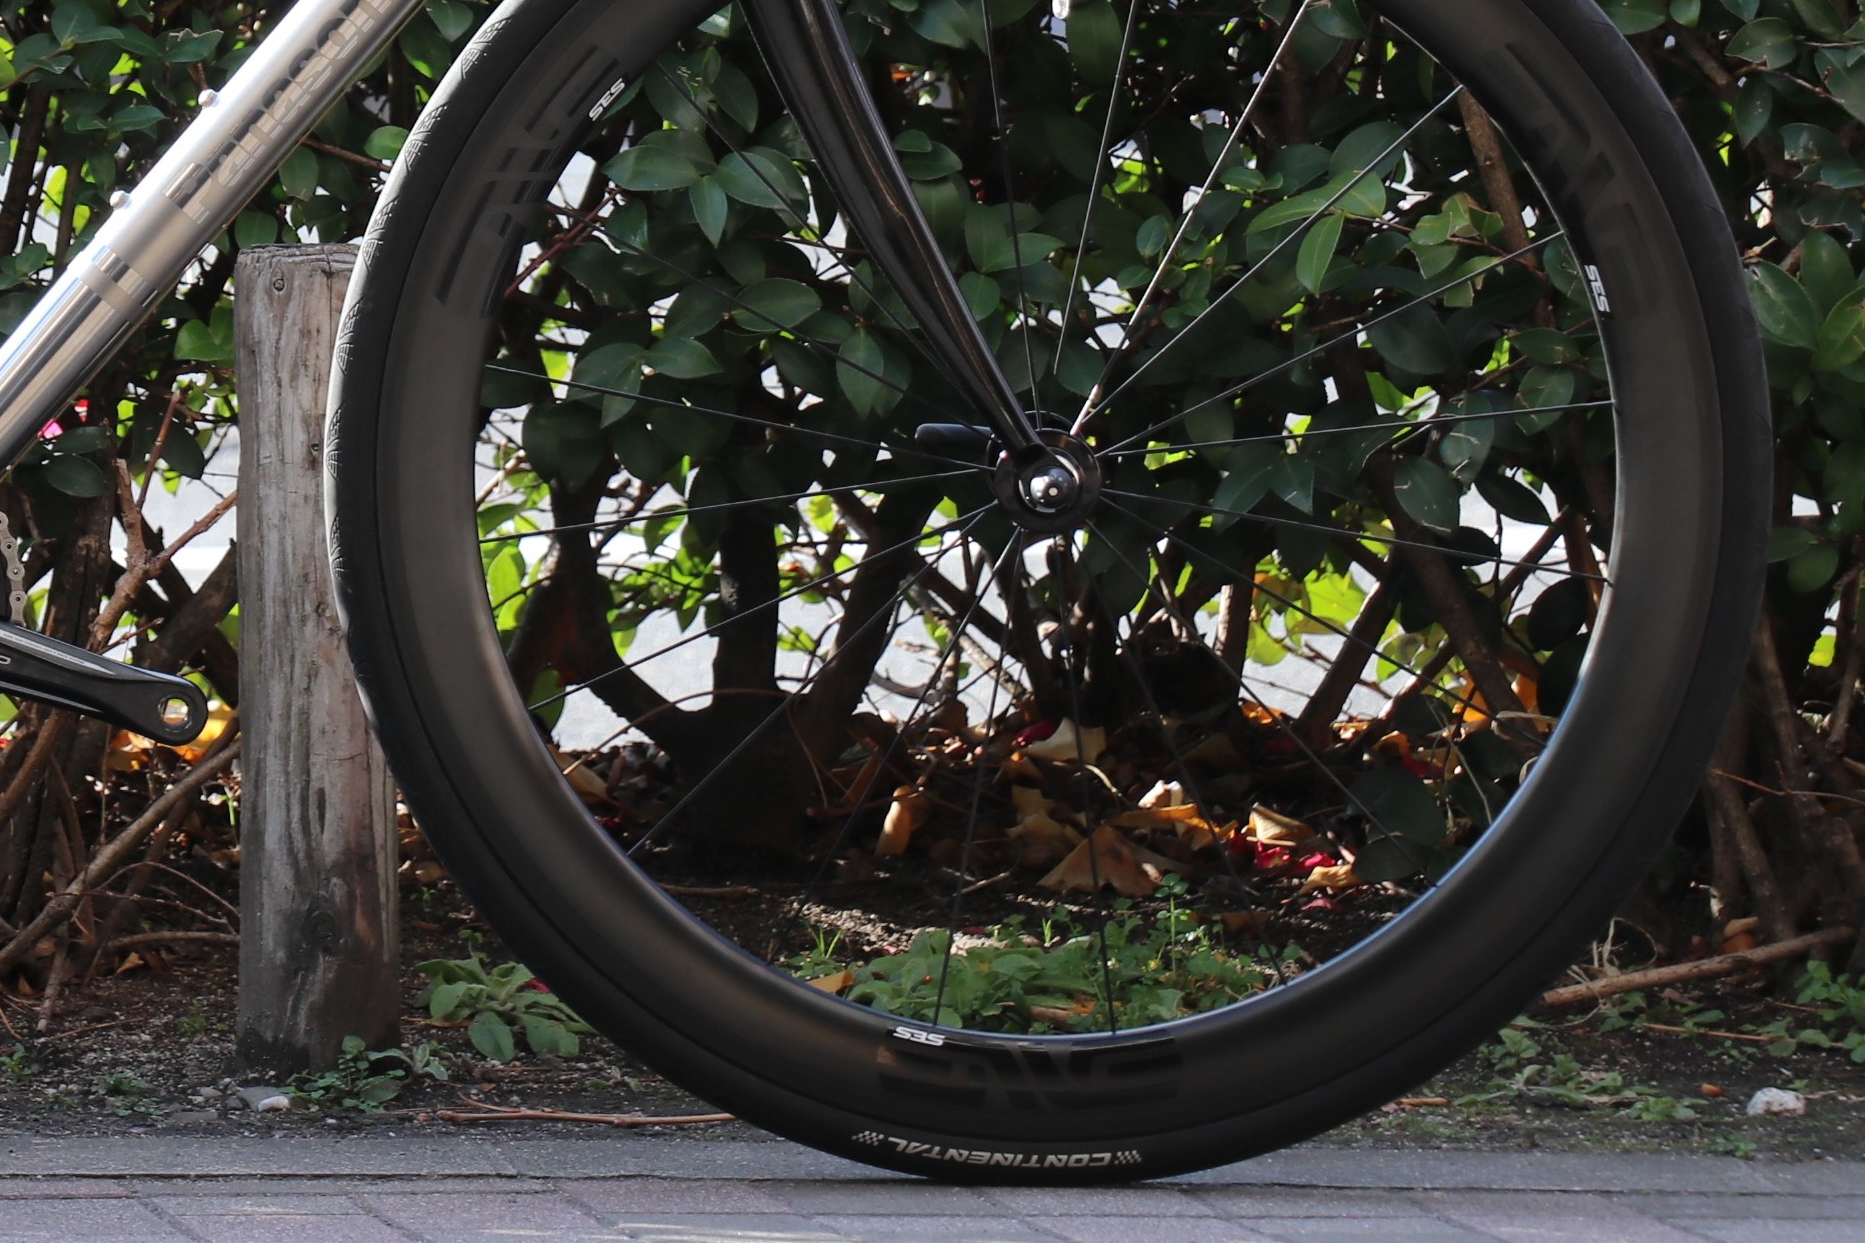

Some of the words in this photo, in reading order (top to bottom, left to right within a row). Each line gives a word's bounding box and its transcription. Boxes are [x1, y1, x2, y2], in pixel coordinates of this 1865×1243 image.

[588, 77, 626, 122] SES
[1583, 264, 1611, 313] SES
[893, 1026, 947, 1047] SES
[888, 1136, 1113, 1168] CONTINENTAL
